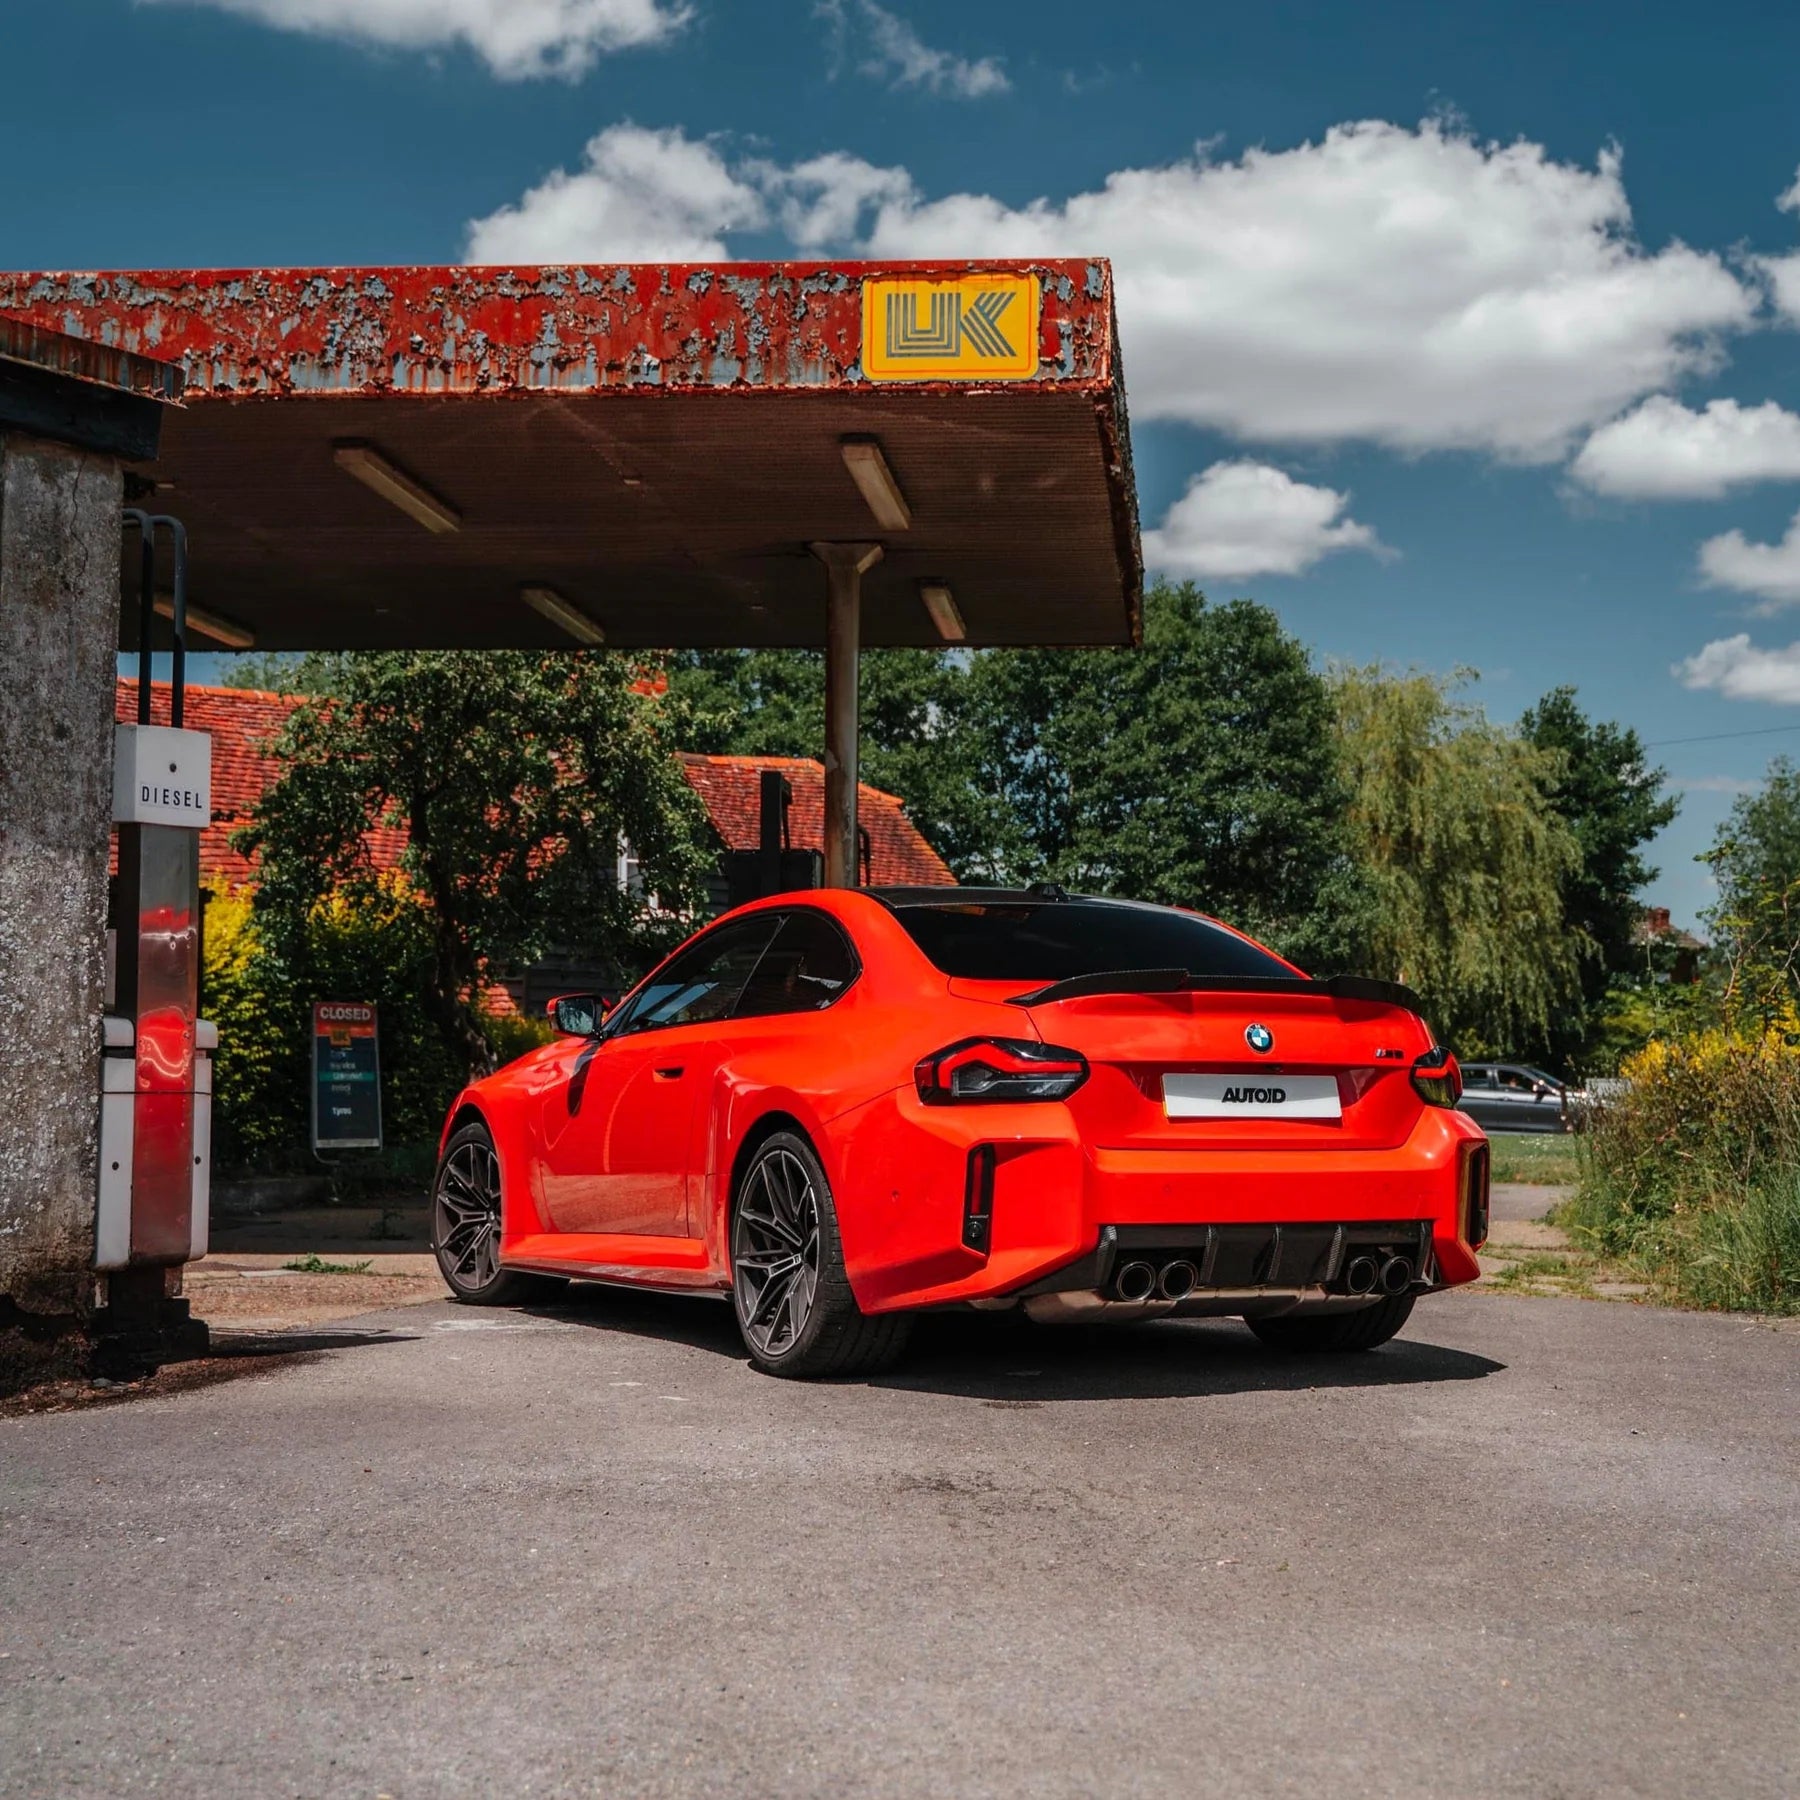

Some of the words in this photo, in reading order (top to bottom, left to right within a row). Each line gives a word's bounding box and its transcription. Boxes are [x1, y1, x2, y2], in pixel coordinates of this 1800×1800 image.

[886, 292, 1018, 358] UK
[141, 785, 203, 809] DIESEL
[319, 1007, 371, 1021] CLOSED
[1221, 1087, 1287, 1104] AUTOID
